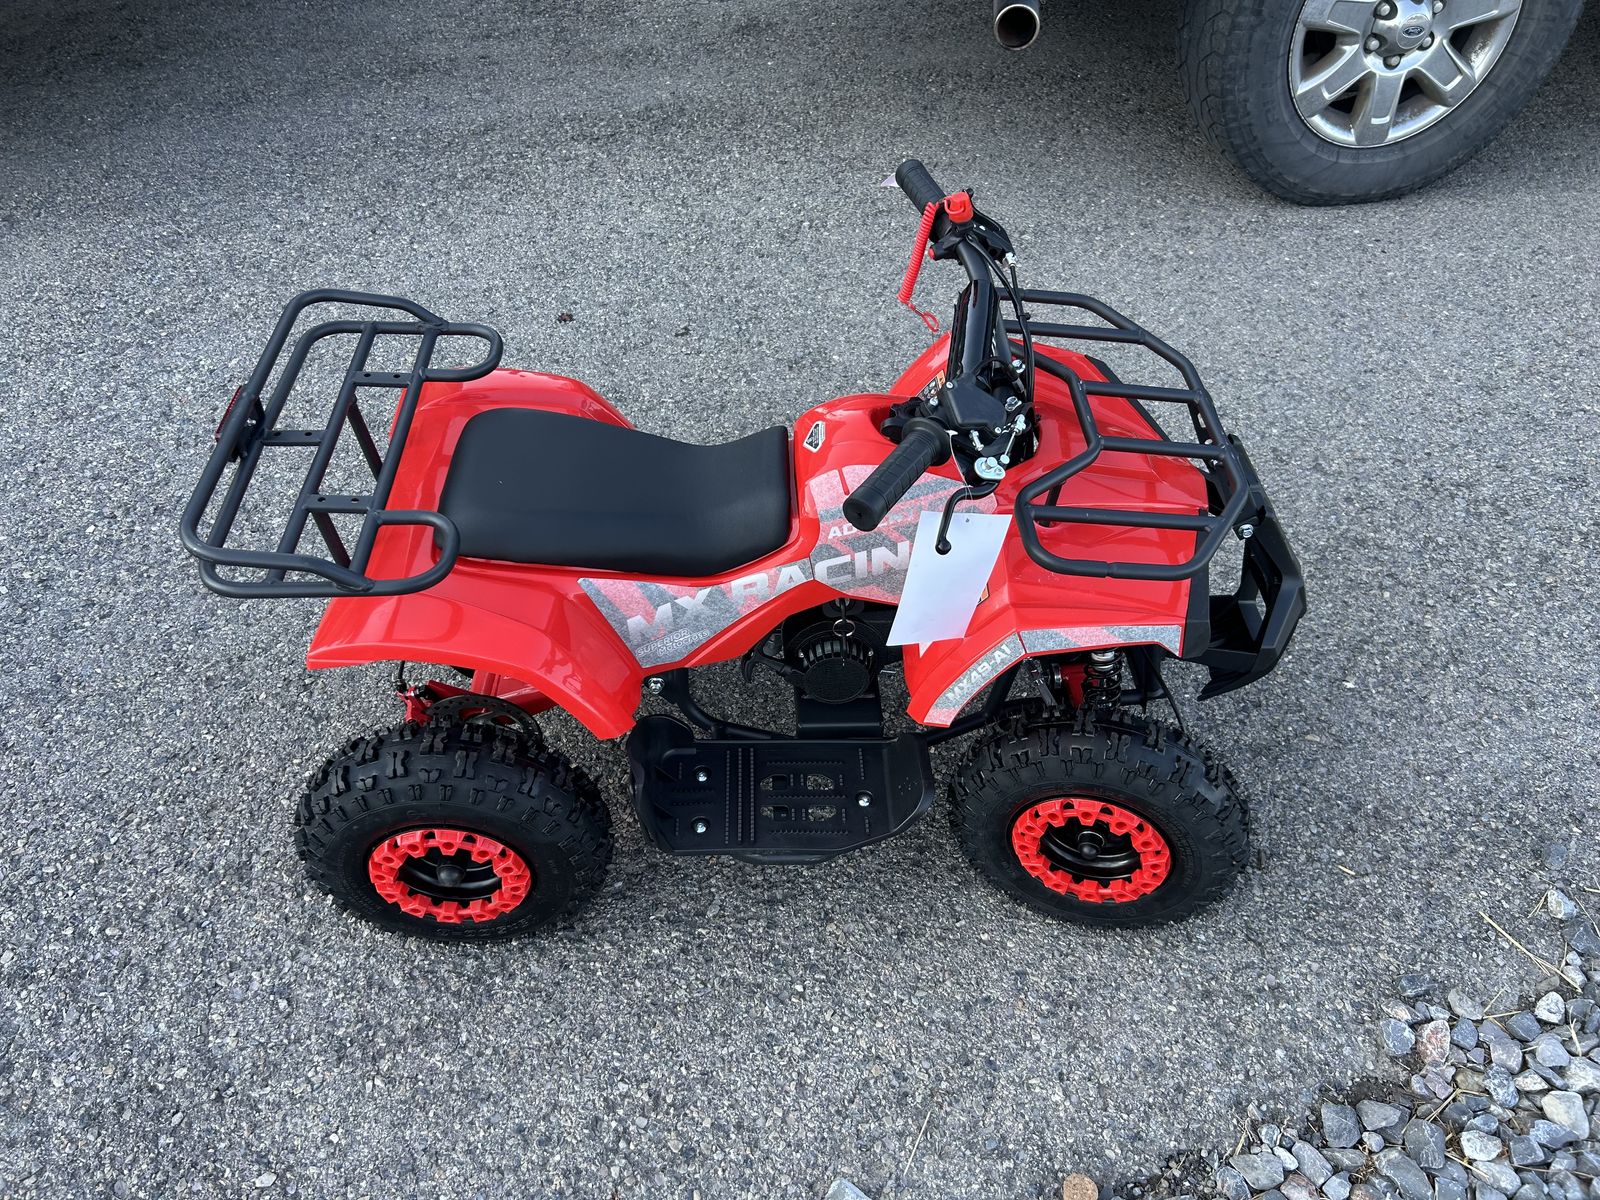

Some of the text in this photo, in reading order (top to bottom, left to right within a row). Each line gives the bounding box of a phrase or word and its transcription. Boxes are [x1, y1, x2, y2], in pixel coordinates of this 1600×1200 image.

[627, 540, 910, 647] MX RACIN
[637, 628, 691, 656] SUPERIOR
[945, 643, 1012, 702] MX49-A1
